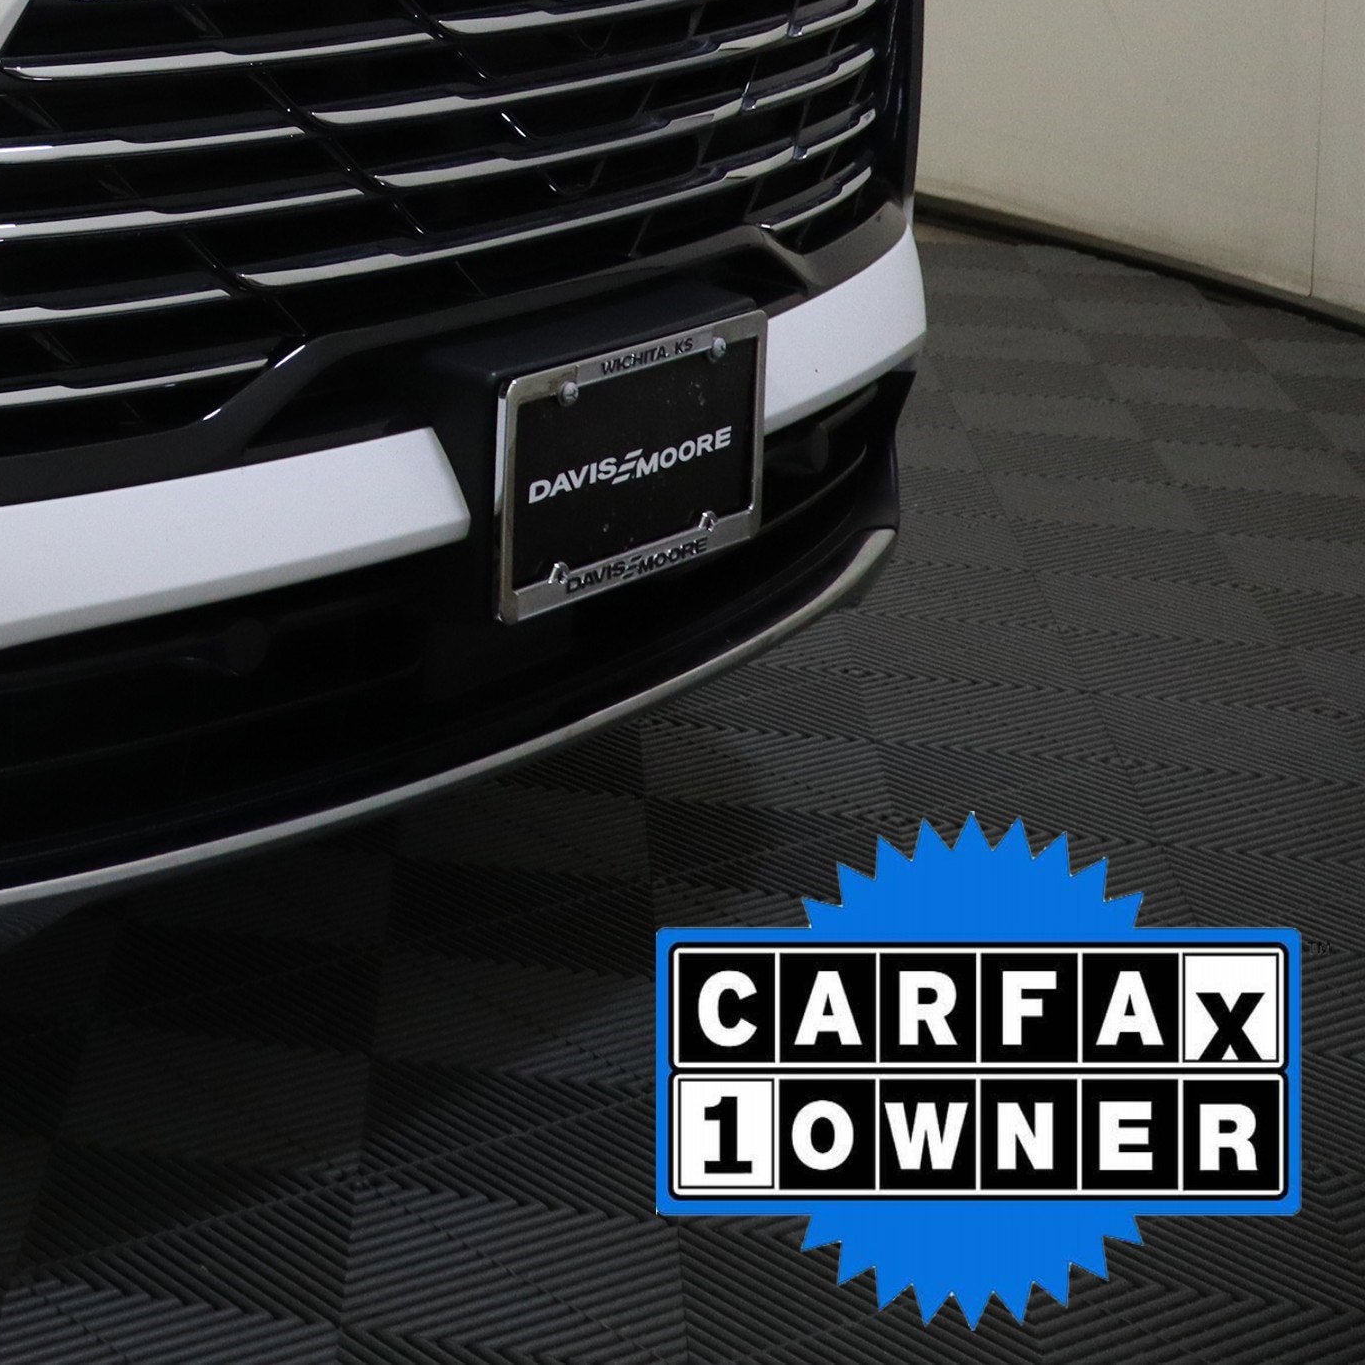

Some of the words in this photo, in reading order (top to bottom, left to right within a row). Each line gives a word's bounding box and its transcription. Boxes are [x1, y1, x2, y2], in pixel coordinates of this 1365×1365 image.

[674, 337, 694, 356] KS
[528, 457, 618, 505] DAVIS
[635, 425, 733, 479] MOORE
